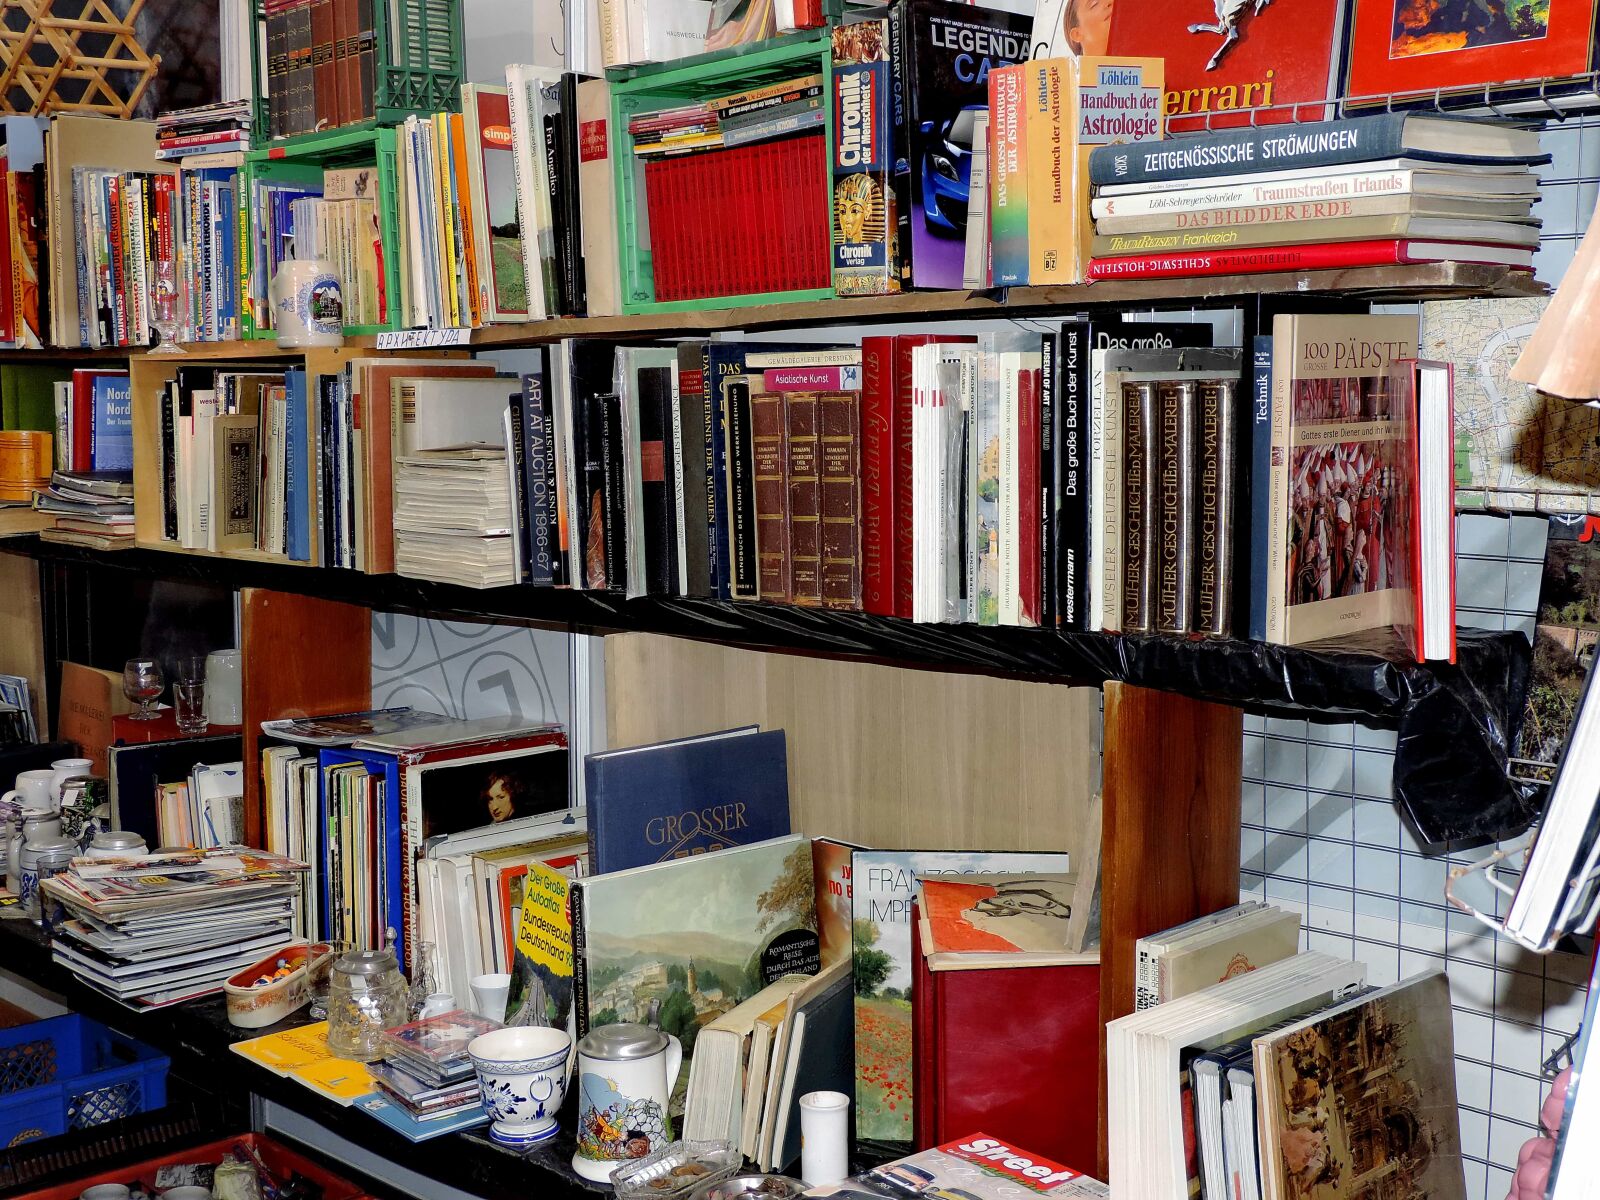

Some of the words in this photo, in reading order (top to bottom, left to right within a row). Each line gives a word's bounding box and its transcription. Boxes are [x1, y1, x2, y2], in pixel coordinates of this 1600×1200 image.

[1037, 68, 1048, 112] Löhlein
[1050, 66, 1061, 123] Astrologie
[1101, 70, 1139, 86] Löhlein
[508, 81, 516, 125] Europas
[860, 85, 871, 145] Menschheit
[893, 81, 903, 126] CARS
[996, 74, 1006, 135] LEHRBUCH
[1006, 71, 1018, 144] ASTROLOGIE
[1080, 92, 1137, 110] Handbuch
[1140, 92, 1159, 110] der
[545, 126, 553, 144] Fra
[839, 72, 860, 166] Chronik
[1050, 125, 1060, 142] der
[1080, 111, 1158, 141] Astrologie
[510, 126, 522, 185] Geschichte
[861, 146, 871, 164] der
[998, 136, 1007, 181] GROSSE
[1008, 149, 1018, 173] DER
[1114, 155, 1128, 176] SKIRA
[1144, 142, 1254, 172] ZEITGENÖSSISCHE
[1262, 129, 1358, 159] STRÖMUNGEN
[547, 148, 558, 196] Angelico
[1051, 144, 1061, 204] Handbuch
[1253, 182, 1349, 202] Traumstraßen
[1353, 173, 1403, 193] Irlands
[515, 188, 523, 208] und
[998, 183, 1007, 207] DAS
[107, 201, 118, 244] REKORDE
[202, 203, 211, 246] REKORDE
[517, 209, 526, 241] Kultur
[1175, 212, 1209, 228] DAS
[1214, 207, 1255, 225] BILD
[1260, 205, 1296, 222] DER
[1301, 200, 1353, 218] ERDE
[110, 245, 119, 264] DER
[839, 245, 872, 258] Chronik
[1182, 230, 1238, 246] Frankreich
[203, 246, 211, 266] DER
[1092, 256, 1211, 275] SCHLESWIG-HOLSTEIN
[112, 265, 121, 291] BUCH
[522, 264, 532, 306] Bildatlas
[115, 293, 125, 341] GUINNESS
[204, 292, 213, 336] GUINNESS
[1042, 341, 1051, 378] MUSEUM
[1066, 331, 1077, 368] Kunst
[1304, 342, 1330, 360] 100
[1334, 337, 1409, 369] PÄPSTE
[718, 363, 741, 375] DAS
[775, 374, 808, 384] Asiatische
[809, 373, 829, 384] Kunst
[1042, 378, 1051, 389] OF
[1066, 372, 1077, 392] der
[528, 377, 542, 411] ART
[672, 384, 680, 439] PROVENCE
[1042, 390, 1051, 406] ART
[1256, 374, 1268, 424] Technik
[530, 413, 543, 433] AT
[703, 381, 712, 443] GEHEIMNIS
[732, 388, 741, 457] WERKERZIEHUNG
[1066, 395, 1077, 429] Buch
[1092, 370, 1102, 460] PORZELLAN
[1103, 387, 1116, 441] KUNST
[1274, 396, 1285, 438] PÄPSTE
[544, 414, 555, 474] INDUSTRIE
[1067, 431, 1080, 467] große
[1301, 430, 1321, 441] Gottes
[1323, 428, 1339, 439] erste
[1340, 427, 1361, 438] Diener
[1362, 425, 1375, 437] und
[286, 440, 294, 492] EDUARD
[532, 435, 546, 507] AUCTION
[705, 447, 713, 469] DER
[547, 477, 555, 487] &
[706, 473, 715, 523] MUMIEN
[1066, 470, 1077, 496] Das
[1103, 449, 1116, 535] DEUTSCHE
[548, 490, 557, 525] KUNST
[535, 510, 549, 571] 1966-67
[867, 500, 880, 583] ARCHIV
[1064, 548, 1074, 624] westermann
[645, 802, 749, 846] GROSSER
[527, 887, 560, 915] Autoatlas
[529, 870, 543, 887] Der
[544, 876, 566, 898] Große
[404, 892, 412, 968] HOLLYWOOD
[573, 890, 583, 956] ROMANTISCHE
[520, 926, 565, 961] Deutschland
[769, 938, 816, 956] ROMANTISCHE
[783, 950, 803, 961] REISE
[576, 958, 584, 984] REISE
[766, 961, 791, 974] DURCH
[791, 958, 805, 968] DAS
[577, 985, 585, 1016] DURCH
[958, 1138, 1075, 1185] Street
